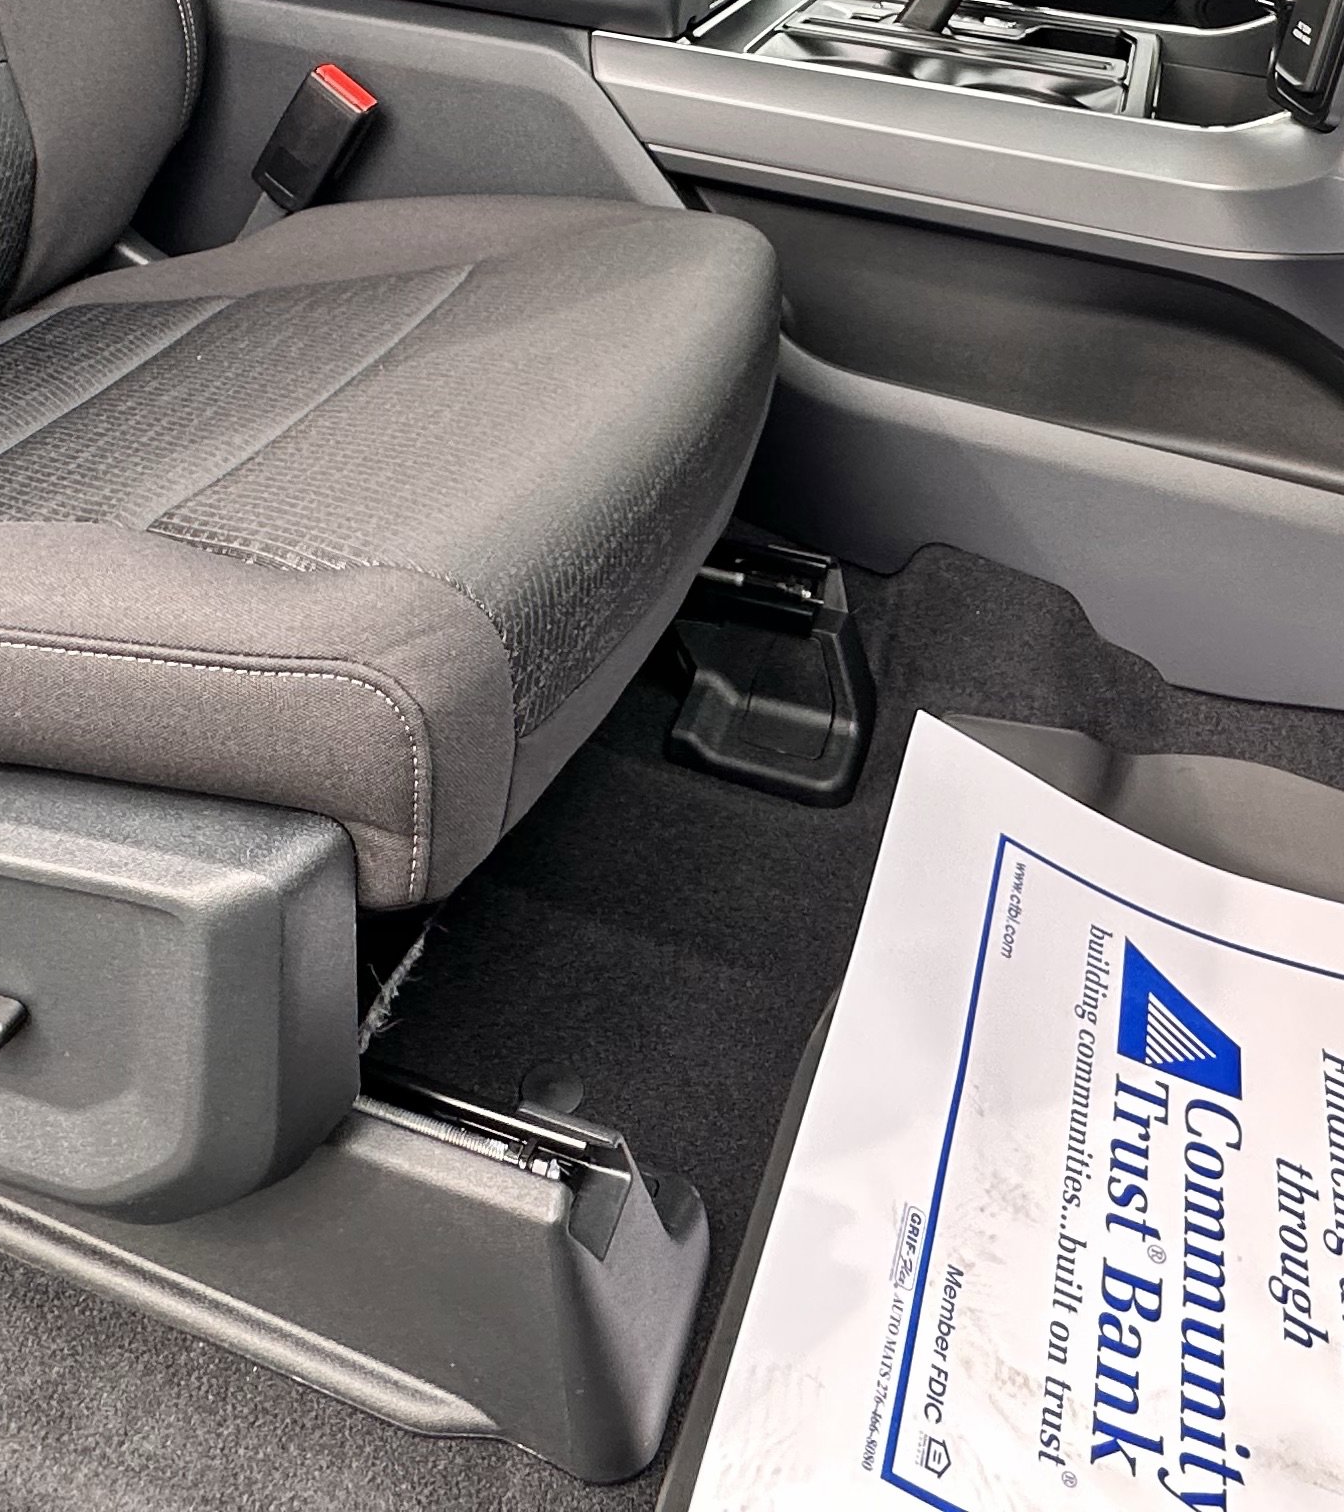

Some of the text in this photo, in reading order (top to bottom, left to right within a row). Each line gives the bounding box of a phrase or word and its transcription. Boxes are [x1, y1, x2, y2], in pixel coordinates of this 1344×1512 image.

[1073, 924, 1112, 1025] building
[886, 1292, 905, 1336] AUTO
[1157, 1098, 1251, 1512] Community
[1267, 1157, 1329, 1349] through
[878, 1335, 897, 1381] MATS
[923, 1264, 964, 1424] Member FDIC
[1045, 1320, 1071, 1366] on
[1089, 1257, 1164, 1479] Bank
